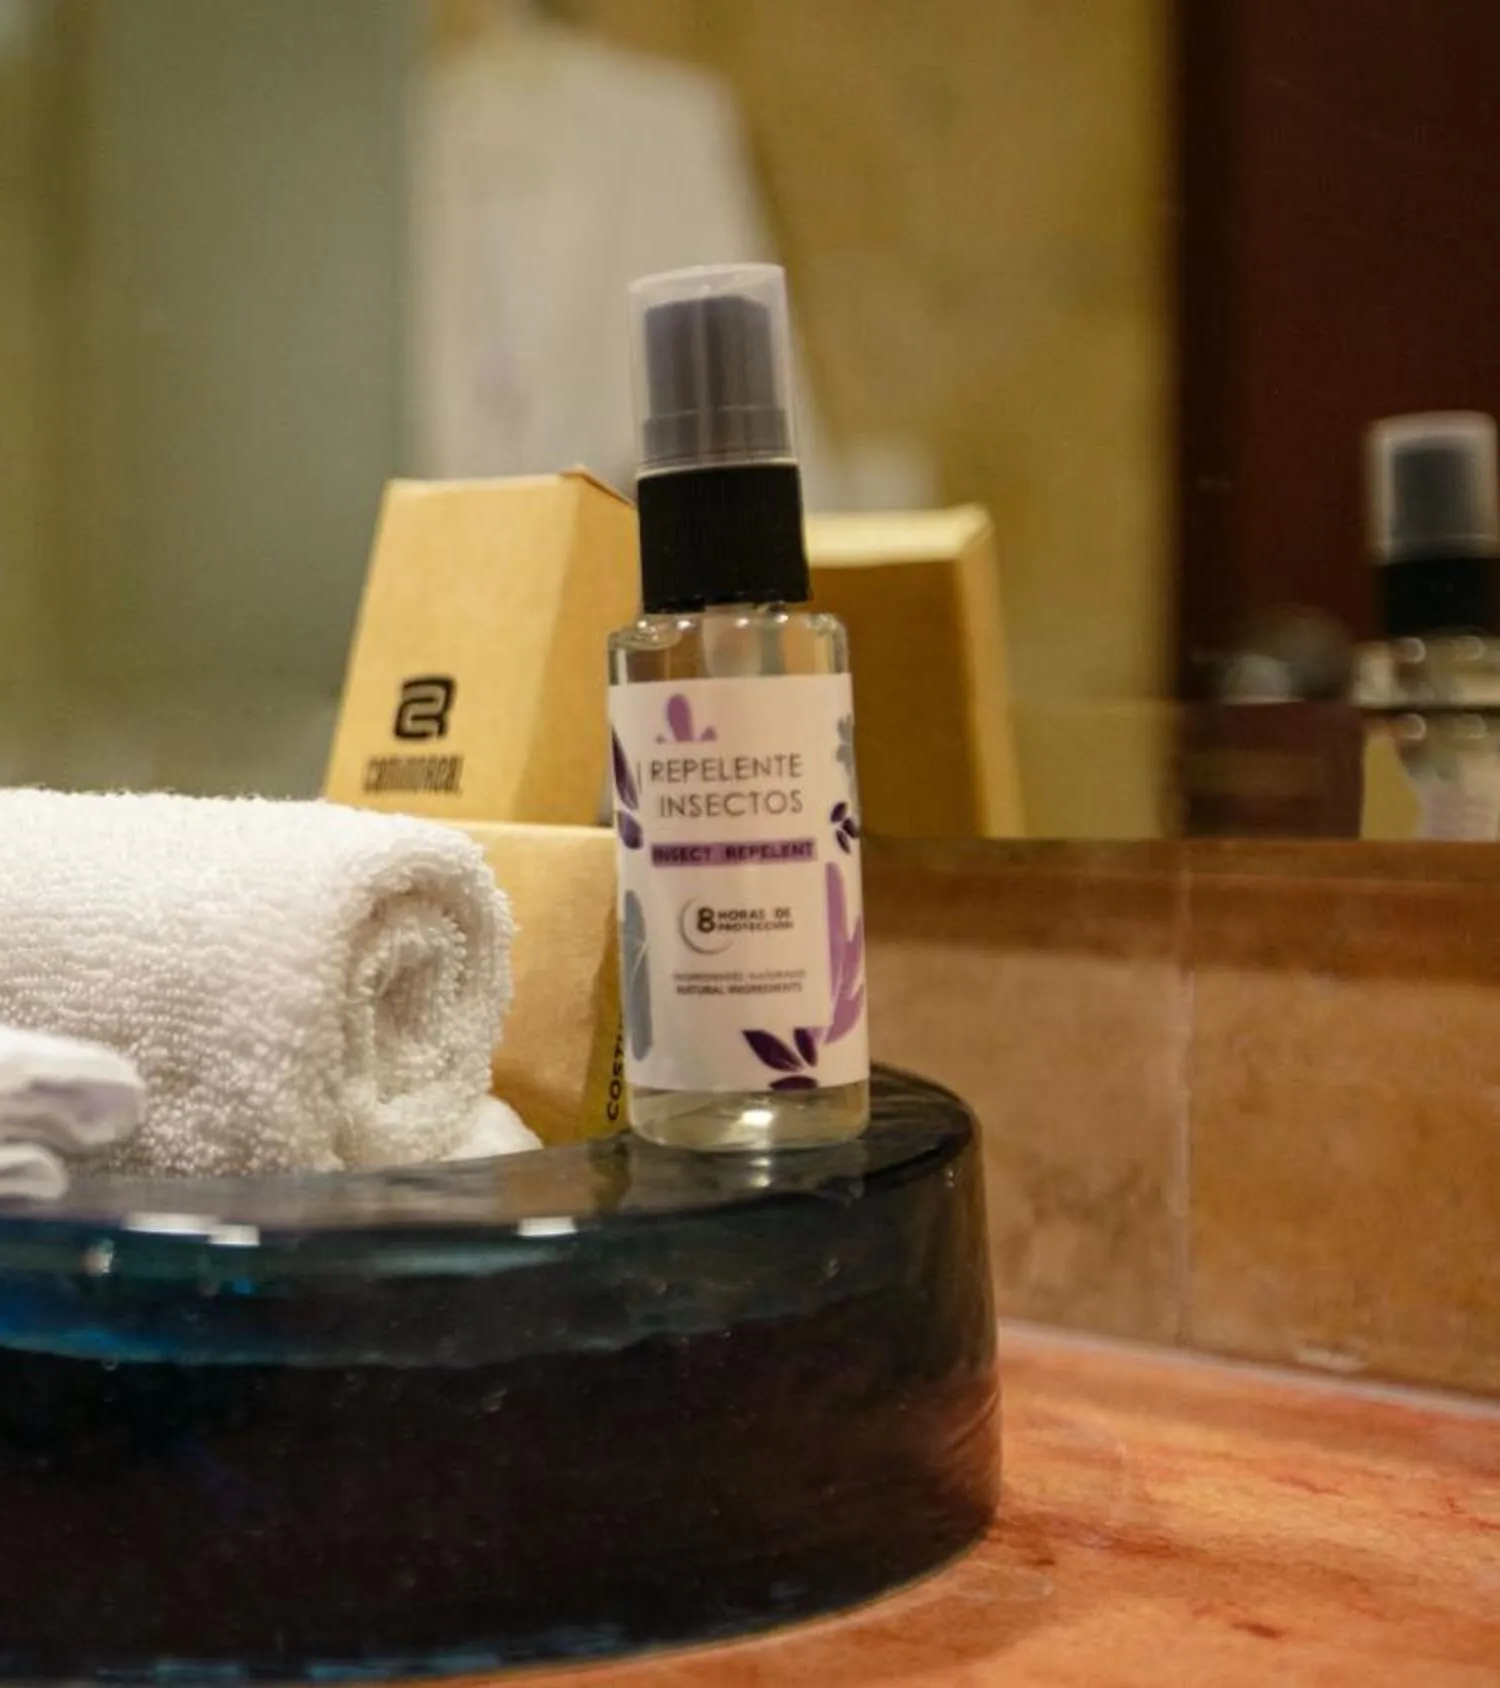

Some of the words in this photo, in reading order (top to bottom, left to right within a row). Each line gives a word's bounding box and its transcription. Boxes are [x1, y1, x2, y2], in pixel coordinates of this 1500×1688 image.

[650, 754, 804, 783] REPELENTE
[659, 790, 804, 818] INSECTOS
[652, 843, 712, 863] INSECT
[725, 841, 814, 861] REPELENT
[696, 906, 717, 934] 8
[717, 908, 766, 921] HORAS
